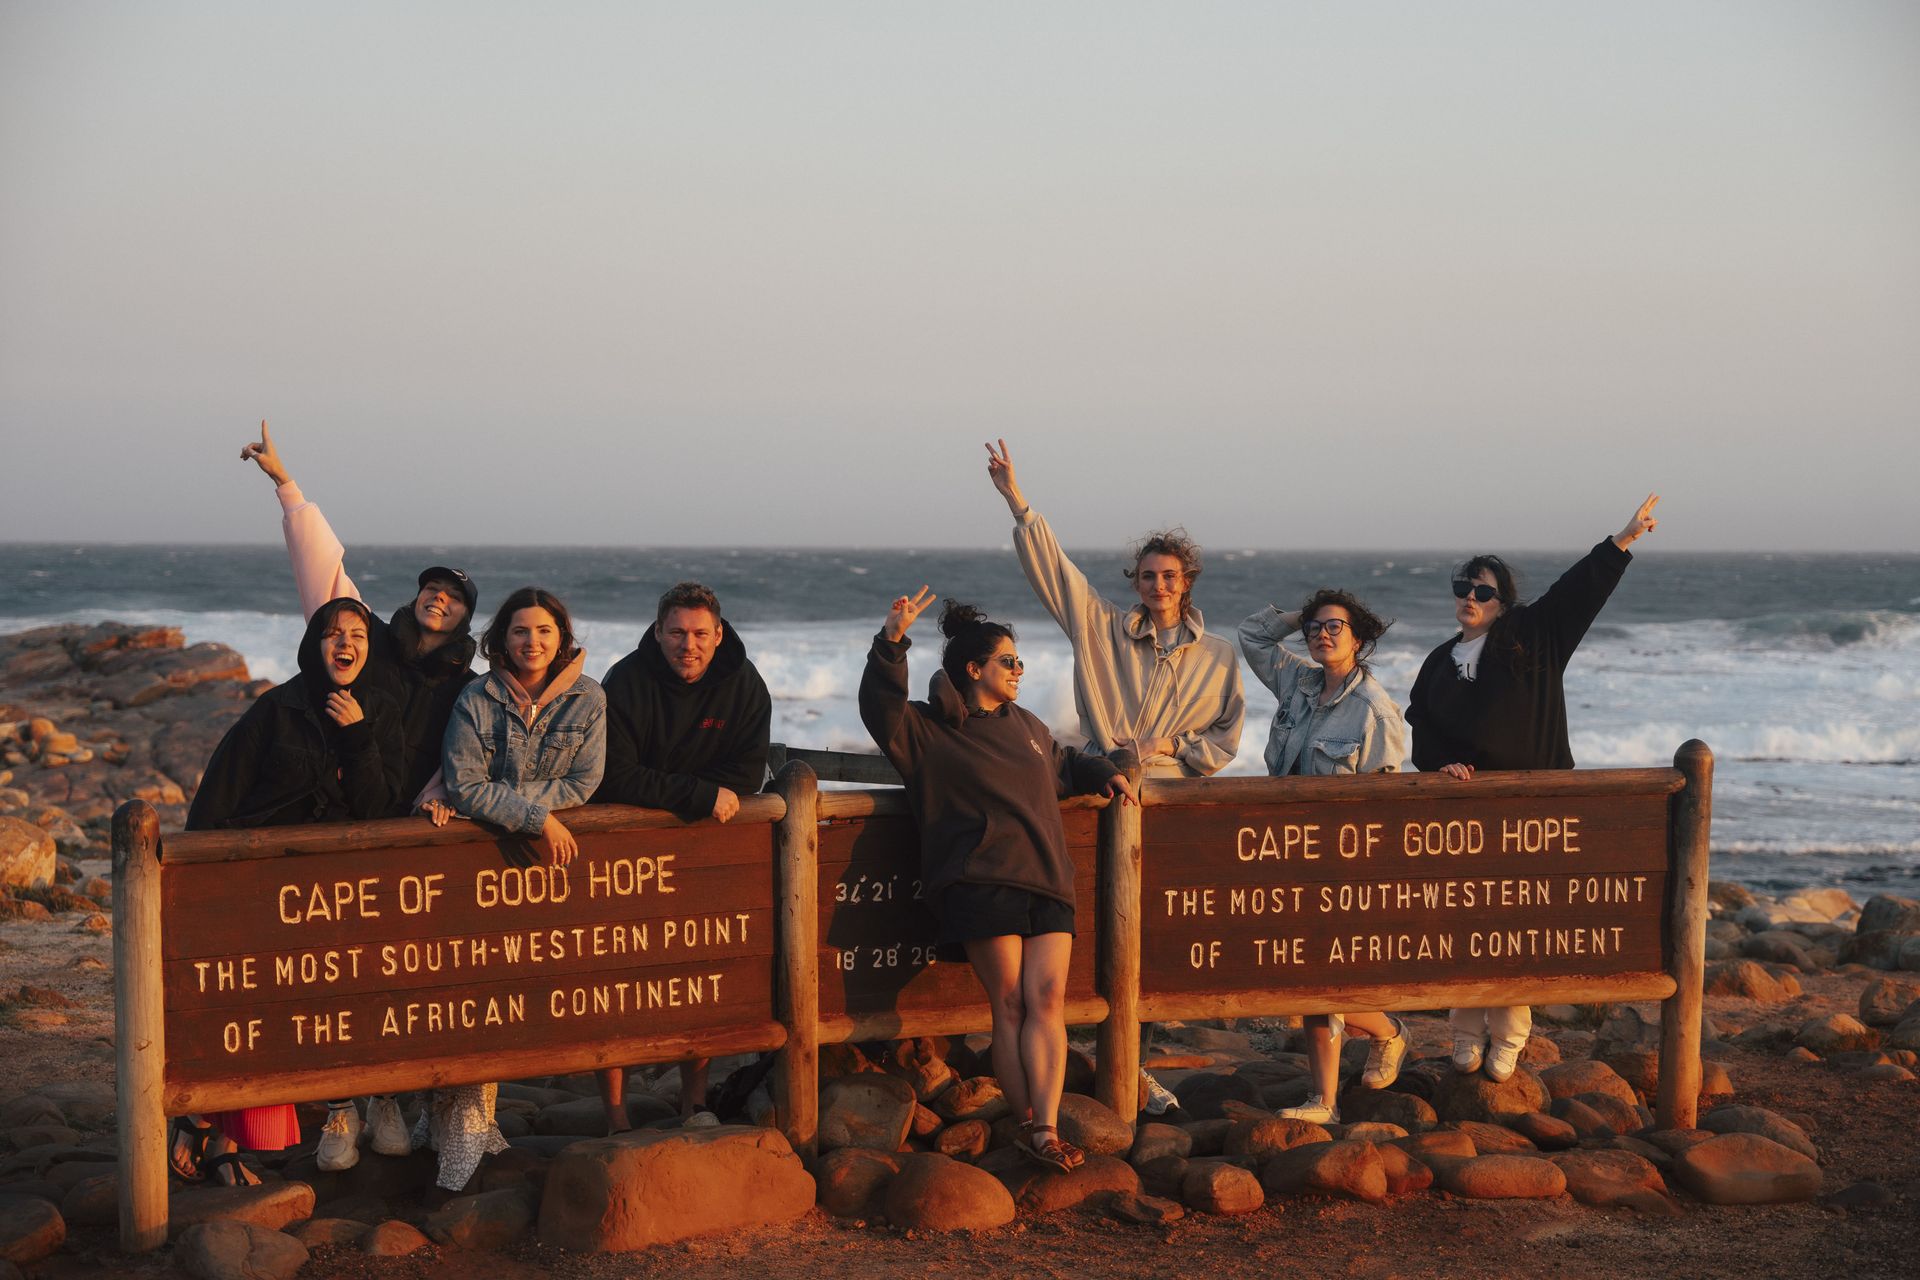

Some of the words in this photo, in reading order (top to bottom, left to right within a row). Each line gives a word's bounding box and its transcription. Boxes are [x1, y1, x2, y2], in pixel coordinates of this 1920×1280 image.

[1237, 824, 1321, 862] CAPE
[1339, 823, 1383, 859] OF
[1403, 820, 1484, 857] GOOD
[1502, 817, 1581, 853] HOPE
[278, 877, 381, 925] CAPE
[399, 873, 445, 915] OF
[476, 865, 571, 909] GOOD
[589, 854, 676, 899] HOPE
[1164, 888, 1216, 917] THE
[1230, 886, 1304, 915] MOST
[1319, 879, 1551, 913] SOUTH-WESTERN
[1568, 876, 1648, 905] POINT
[193, 956, 258, 994] THE
[275, 948, 363, 986] MOST
[381, 923, 649, 976] SOUTH-WESTERN
[663, 913, 751, 949] POINT
[1190, 940, 1222, 969] OF
[1253, 937, 1305, 966] THE
[1328, 933, 1454, 964] AFRICAN
[1470, 927, 1625, 958] CONTINENT
[223, 1018, 263, 1054] OF
[291, 1010, 353, 1045] THE
[381, 993, 525, 1037] AFRICAN
[550, 973, 724, 1018] CONTINENT
